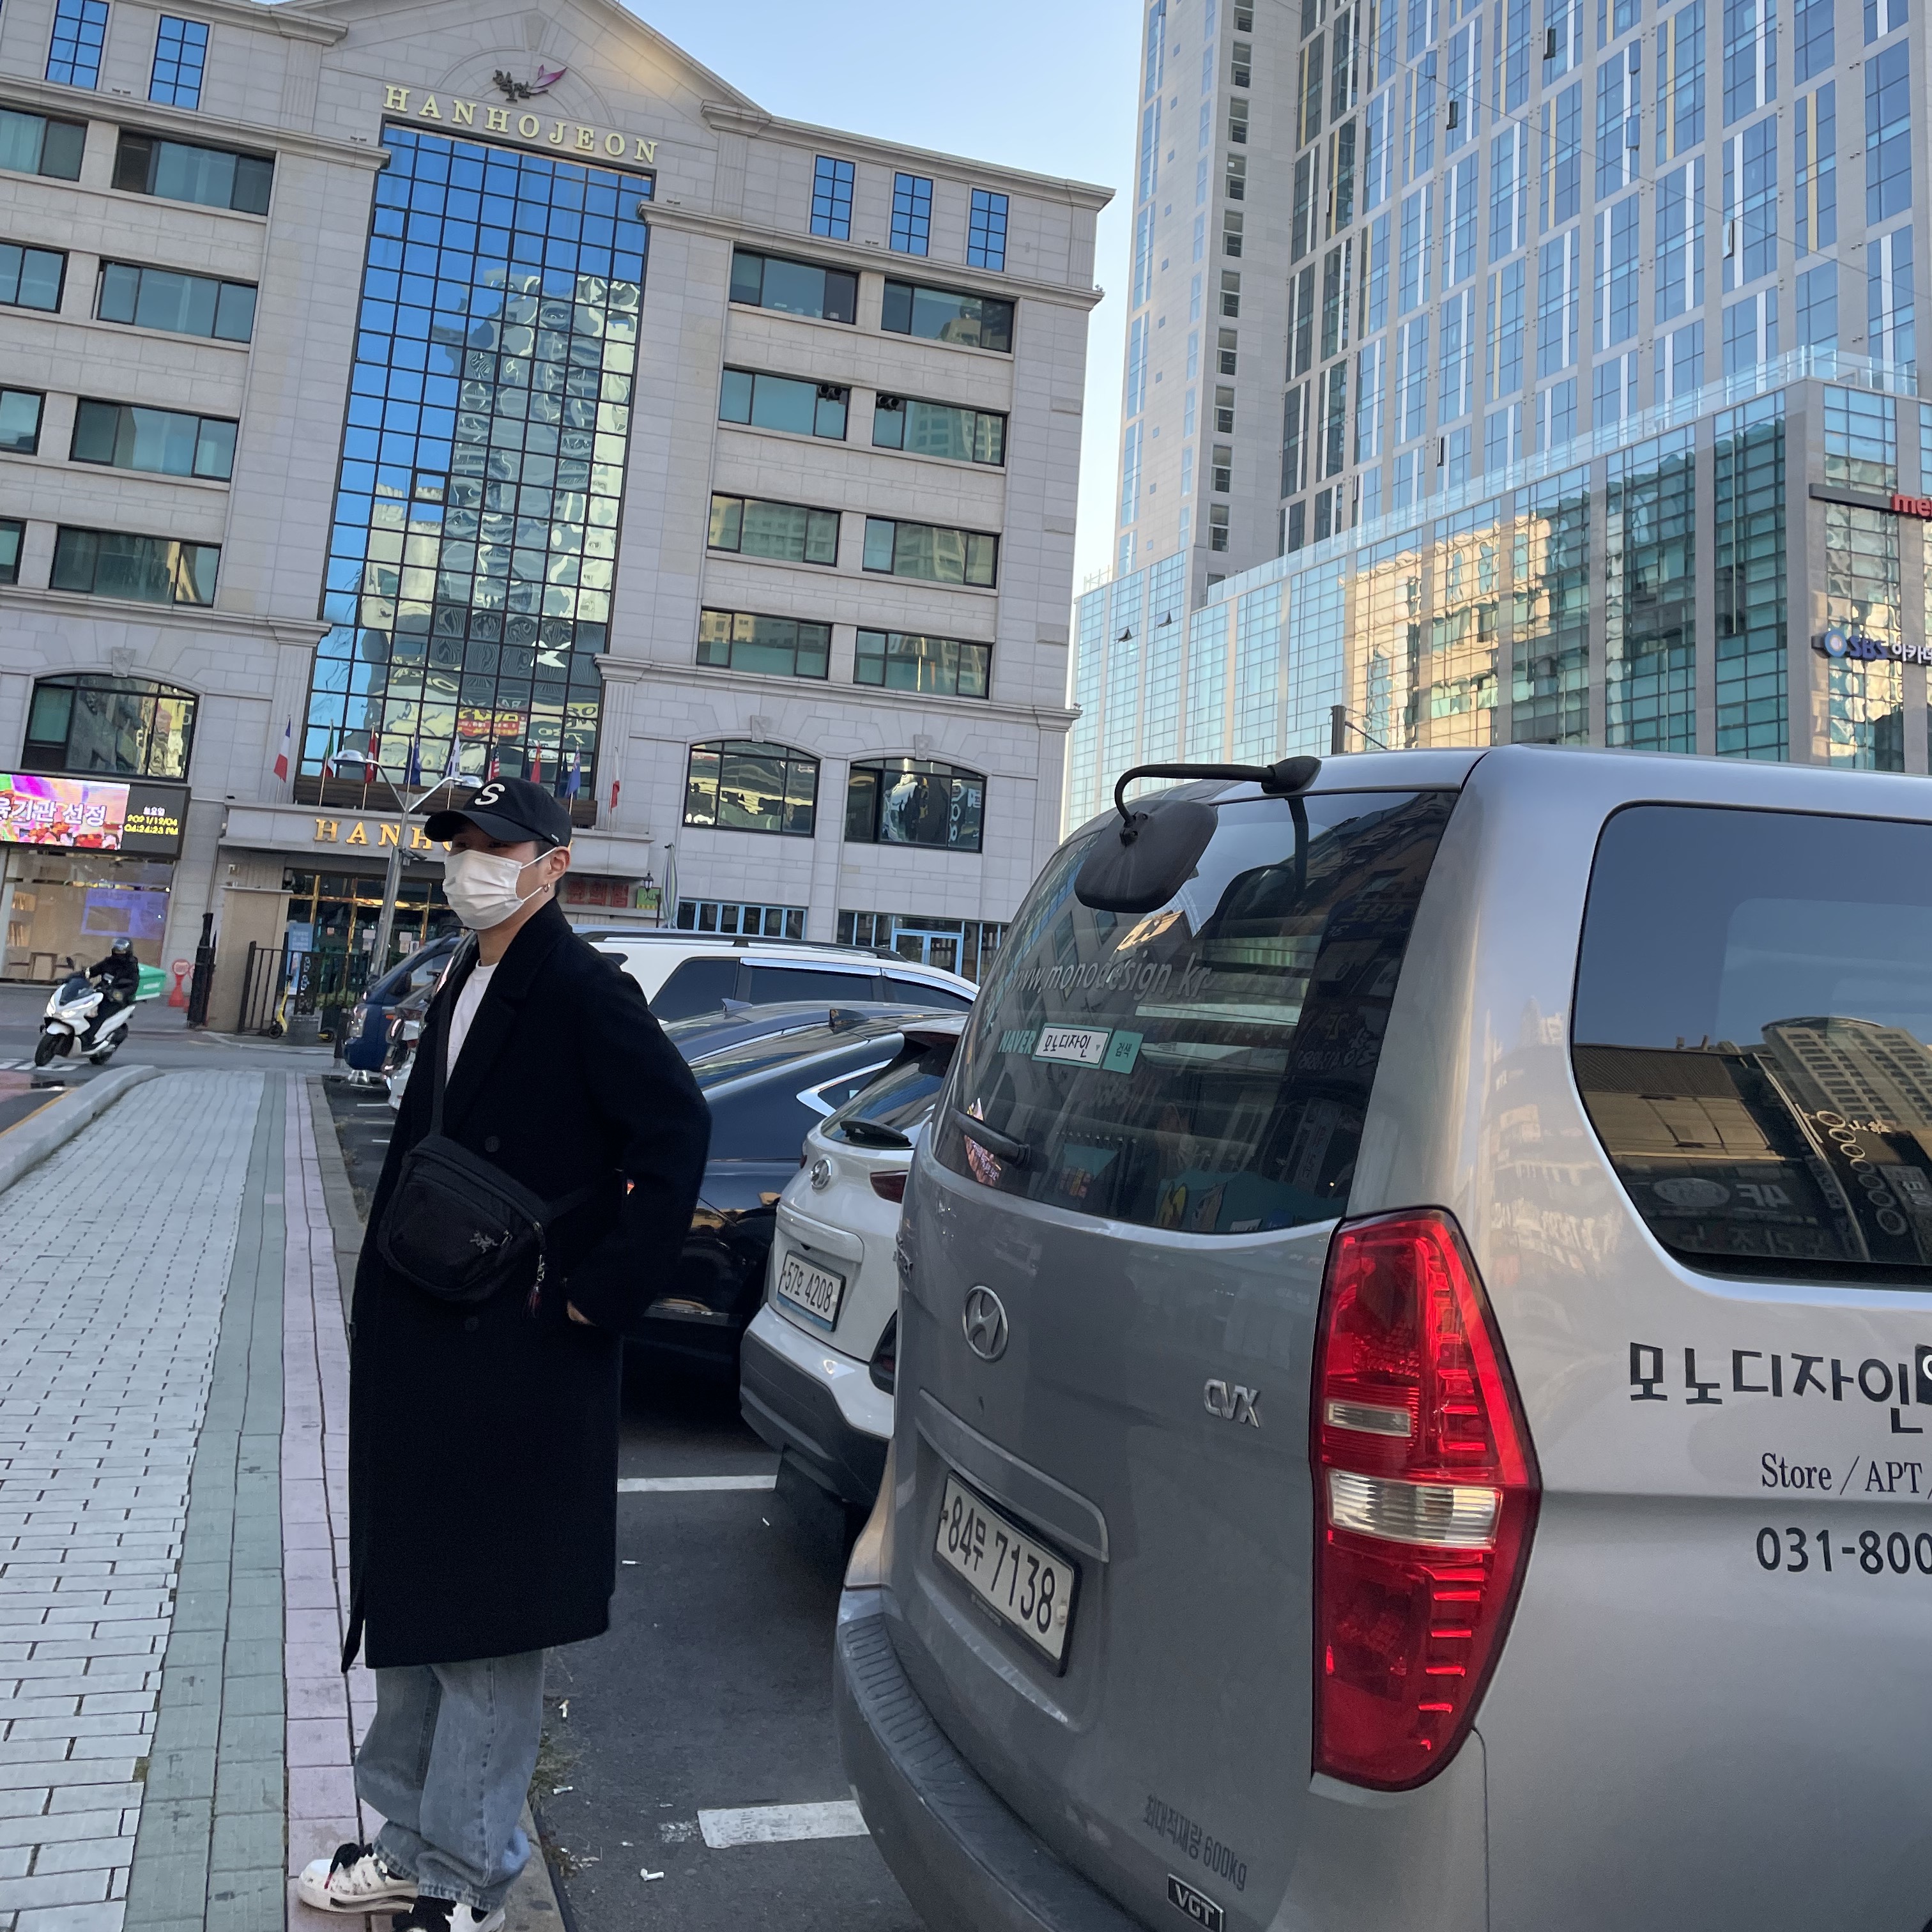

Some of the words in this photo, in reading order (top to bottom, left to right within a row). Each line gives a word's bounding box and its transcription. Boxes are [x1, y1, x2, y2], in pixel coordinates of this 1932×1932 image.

[383, 84, 658, 164] HANHOJEON
[1892, 494, 1932, 517] me
[1849, 635, 1887, 661] SBS
[63, 802, 107, 827] 선정
[473, 783, 505, 806] S
[314, 818, 452, 852] HANH
[999, 1029, 1037, 1054] NAVER
[1043, 1033, 1092, 1059] 모노디자인
[1115, 1041, 1133, 1059] 검색
[804, 1273, 834, 1314] 4208
[1204, 1379, 1260, 1429] CVX
[1630, 1342, 1924, 1434] 모노디자인
[1761, 1452, 1832, 1491] Store
[1865, 1459, 1923, 1494] APT
[948, 1496, 986, 1572] 84무
[991, 1530, 1055, 1635] 7138
[1756, 1526, 1932, 1575] 031-800
[1203, 1835, 1247, 1892] 600kg
[1174, 1883, 1215, 1926] VGT
